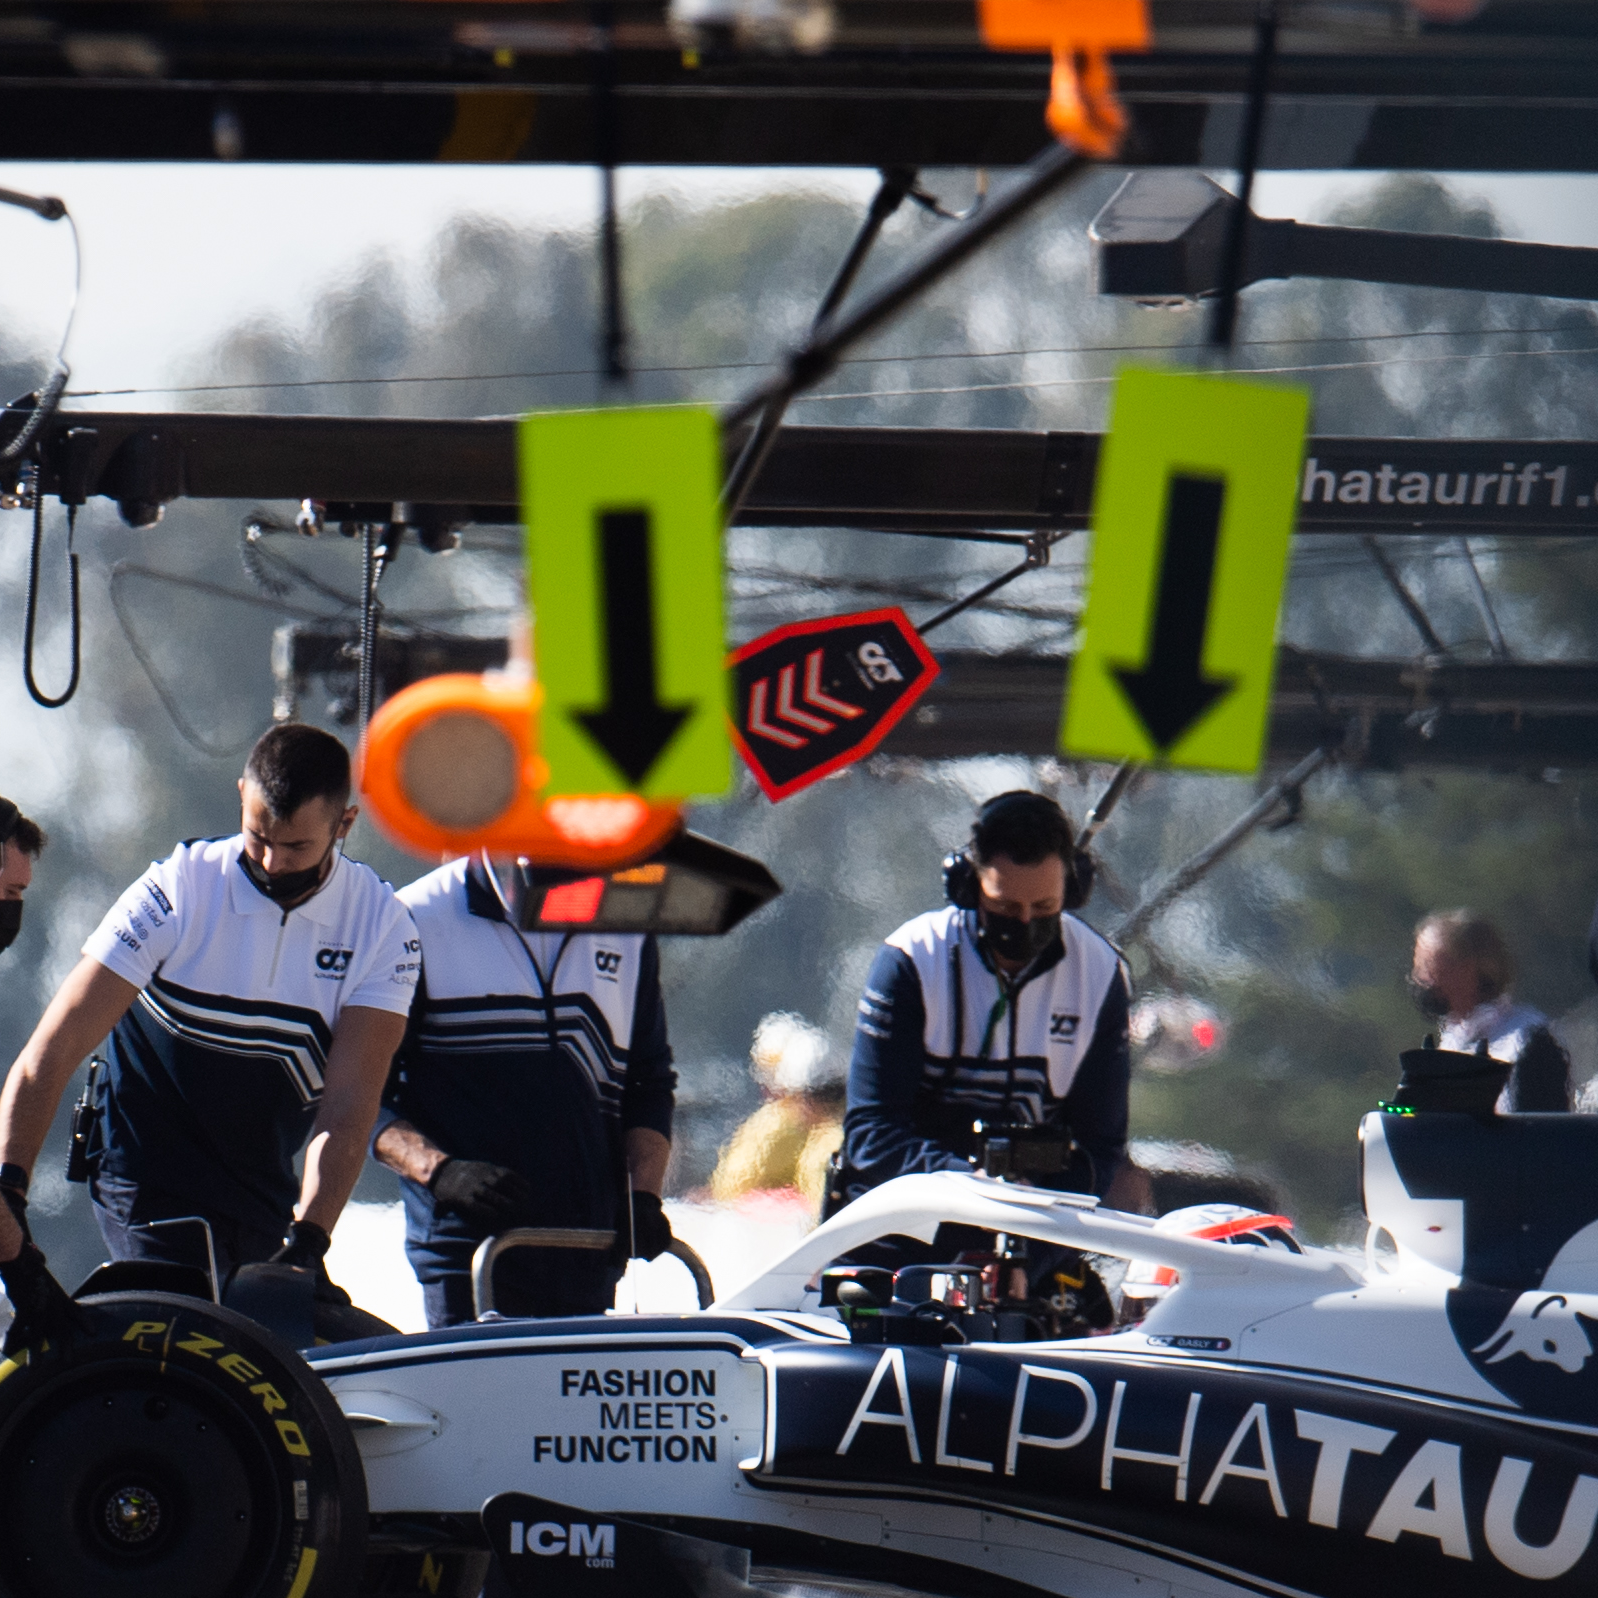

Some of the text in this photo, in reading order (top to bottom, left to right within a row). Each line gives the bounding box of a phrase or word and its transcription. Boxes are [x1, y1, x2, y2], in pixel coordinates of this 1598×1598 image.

[561, 1368, 717, 1397] FASHION
[600, 1401, 717, 1430] MEETS
[533, 1434, 717, 1463] FUNCTION
[509, 1520, 617, 1557] ICM
